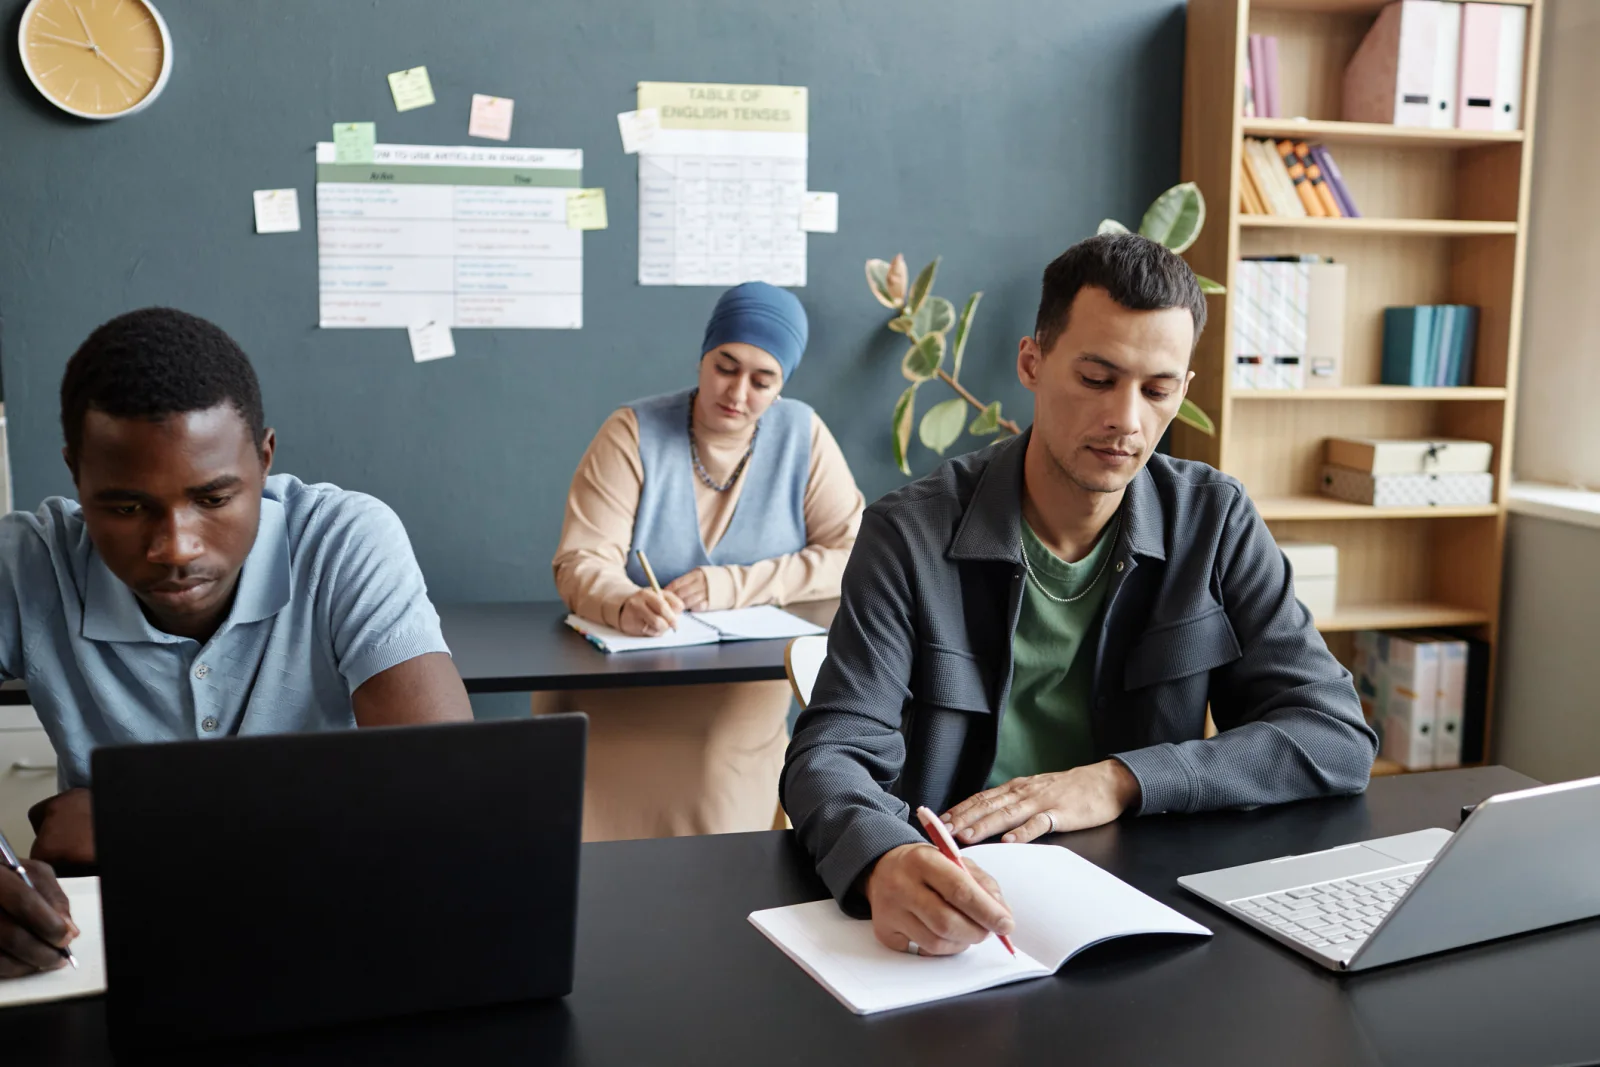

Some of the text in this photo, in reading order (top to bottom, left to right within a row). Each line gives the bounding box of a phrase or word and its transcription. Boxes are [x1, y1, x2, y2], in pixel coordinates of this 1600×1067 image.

[688, 87, 762, 102] TABLE OF
[661, 105, 792, 121] ENGLISH TENSES
[395, 151, 407, 159] TO
[410, 151, 430, 160] USE
[435, 152, 485, 161] ARTICLES
[488, 153, 498, 161] IN
[500, 154, 545, 163] ENGLISH
[513, 174, 532, 184] The
